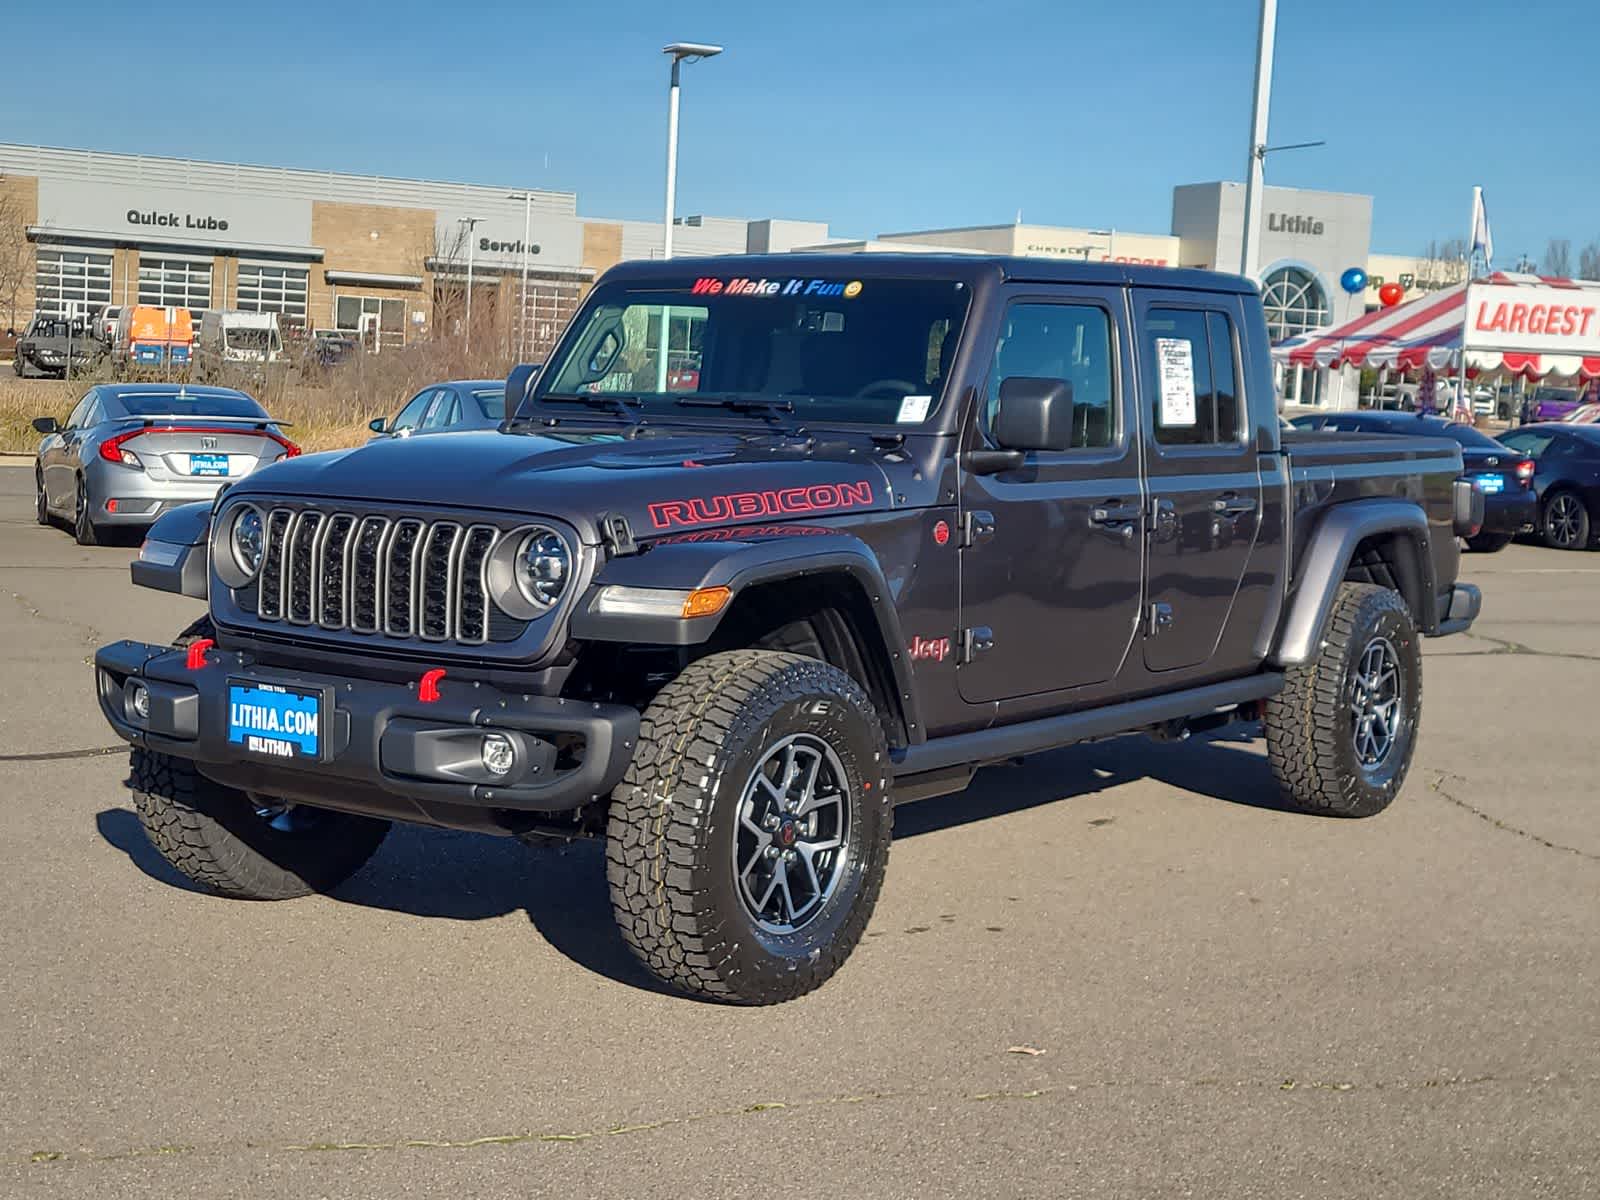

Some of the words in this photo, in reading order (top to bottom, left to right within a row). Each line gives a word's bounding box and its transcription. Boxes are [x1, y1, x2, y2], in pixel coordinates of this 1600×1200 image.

[126, 209, 180, 227] Quick
[185, 214, 229, 231] Lube
[1269, 213, 1324, 235] Lithia
[691, 278, 724, 295] We
[724, 278, 781, 295] Make
[782, 279, 803, 295] It
[804, 280, 846, 296] Fun
[1475, 301, 1595, 336] LARGEST
[648, 480, 873, 528] RUBICON
[908, 636, 950, 661] Jeep
[231, 703, 318, 737] LITHIA.COM
[257, 736, 294, 757] LITHIA
